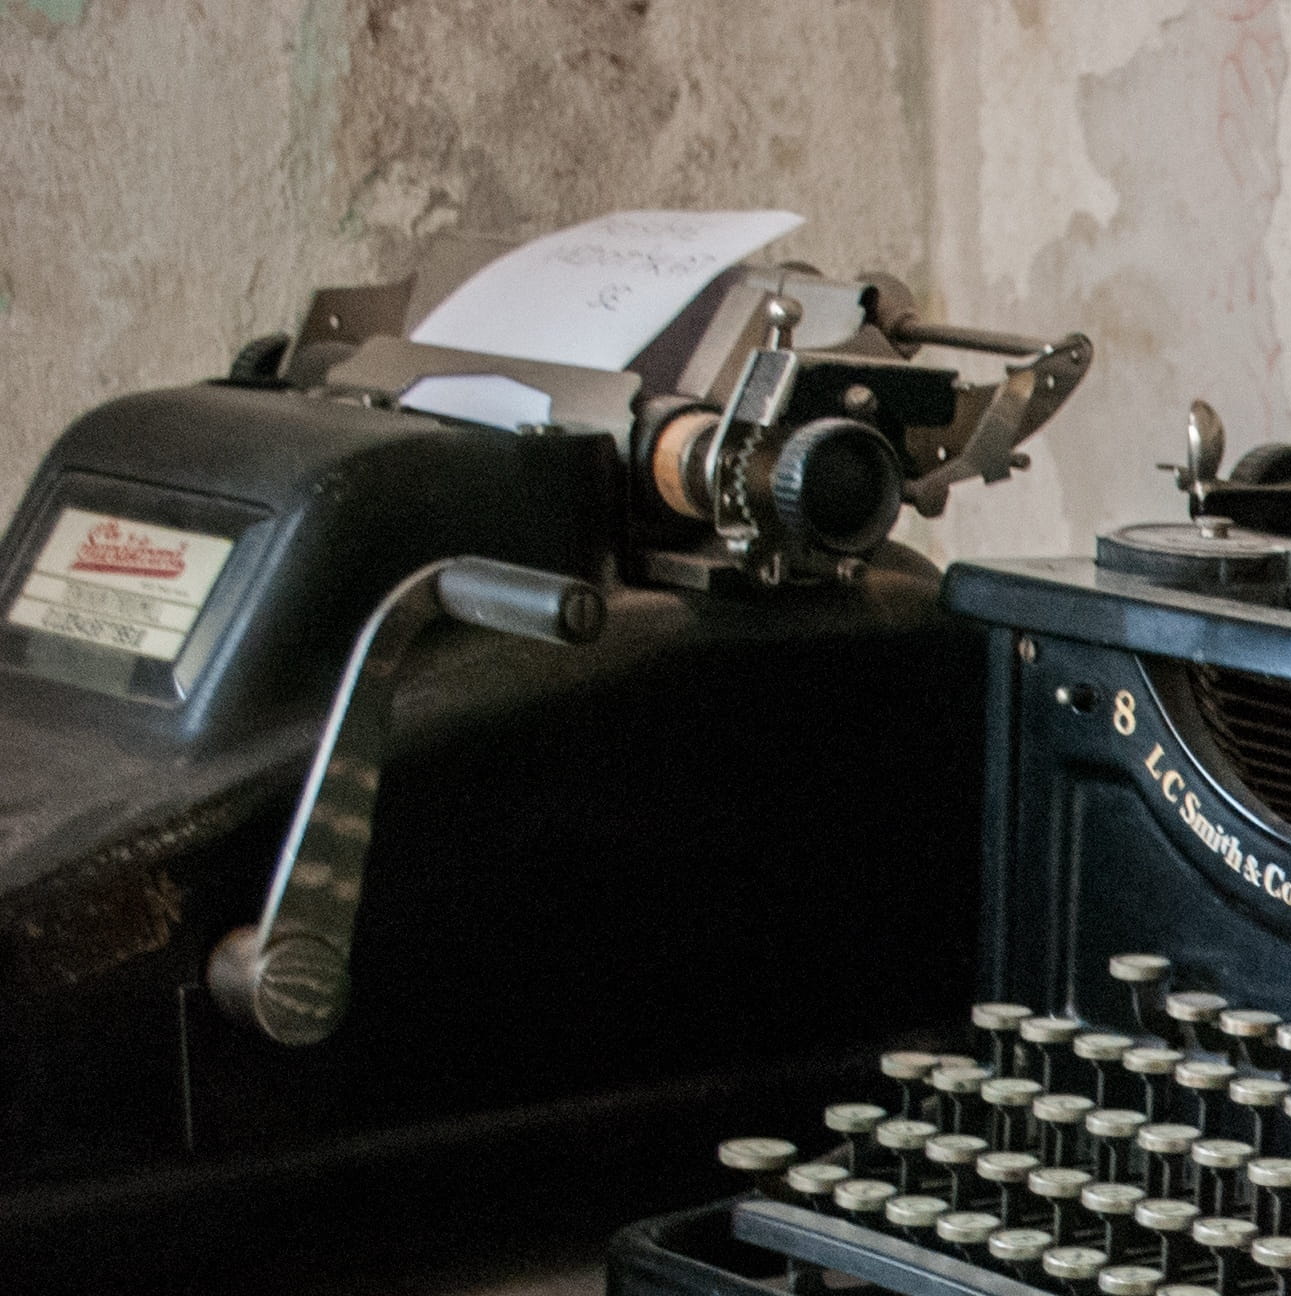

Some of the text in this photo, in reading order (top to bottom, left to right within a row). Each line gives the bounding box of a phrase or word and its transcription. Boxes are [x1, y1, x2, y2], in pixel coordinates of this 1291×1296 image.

[1113, 689, 1136, 736] 8
[1144, 742, 1165, 780] L
[1161, 769, 1186, 803] C
[1178, 791, 1243, 873] Smith
[1243, 854, 1262, 888] &
